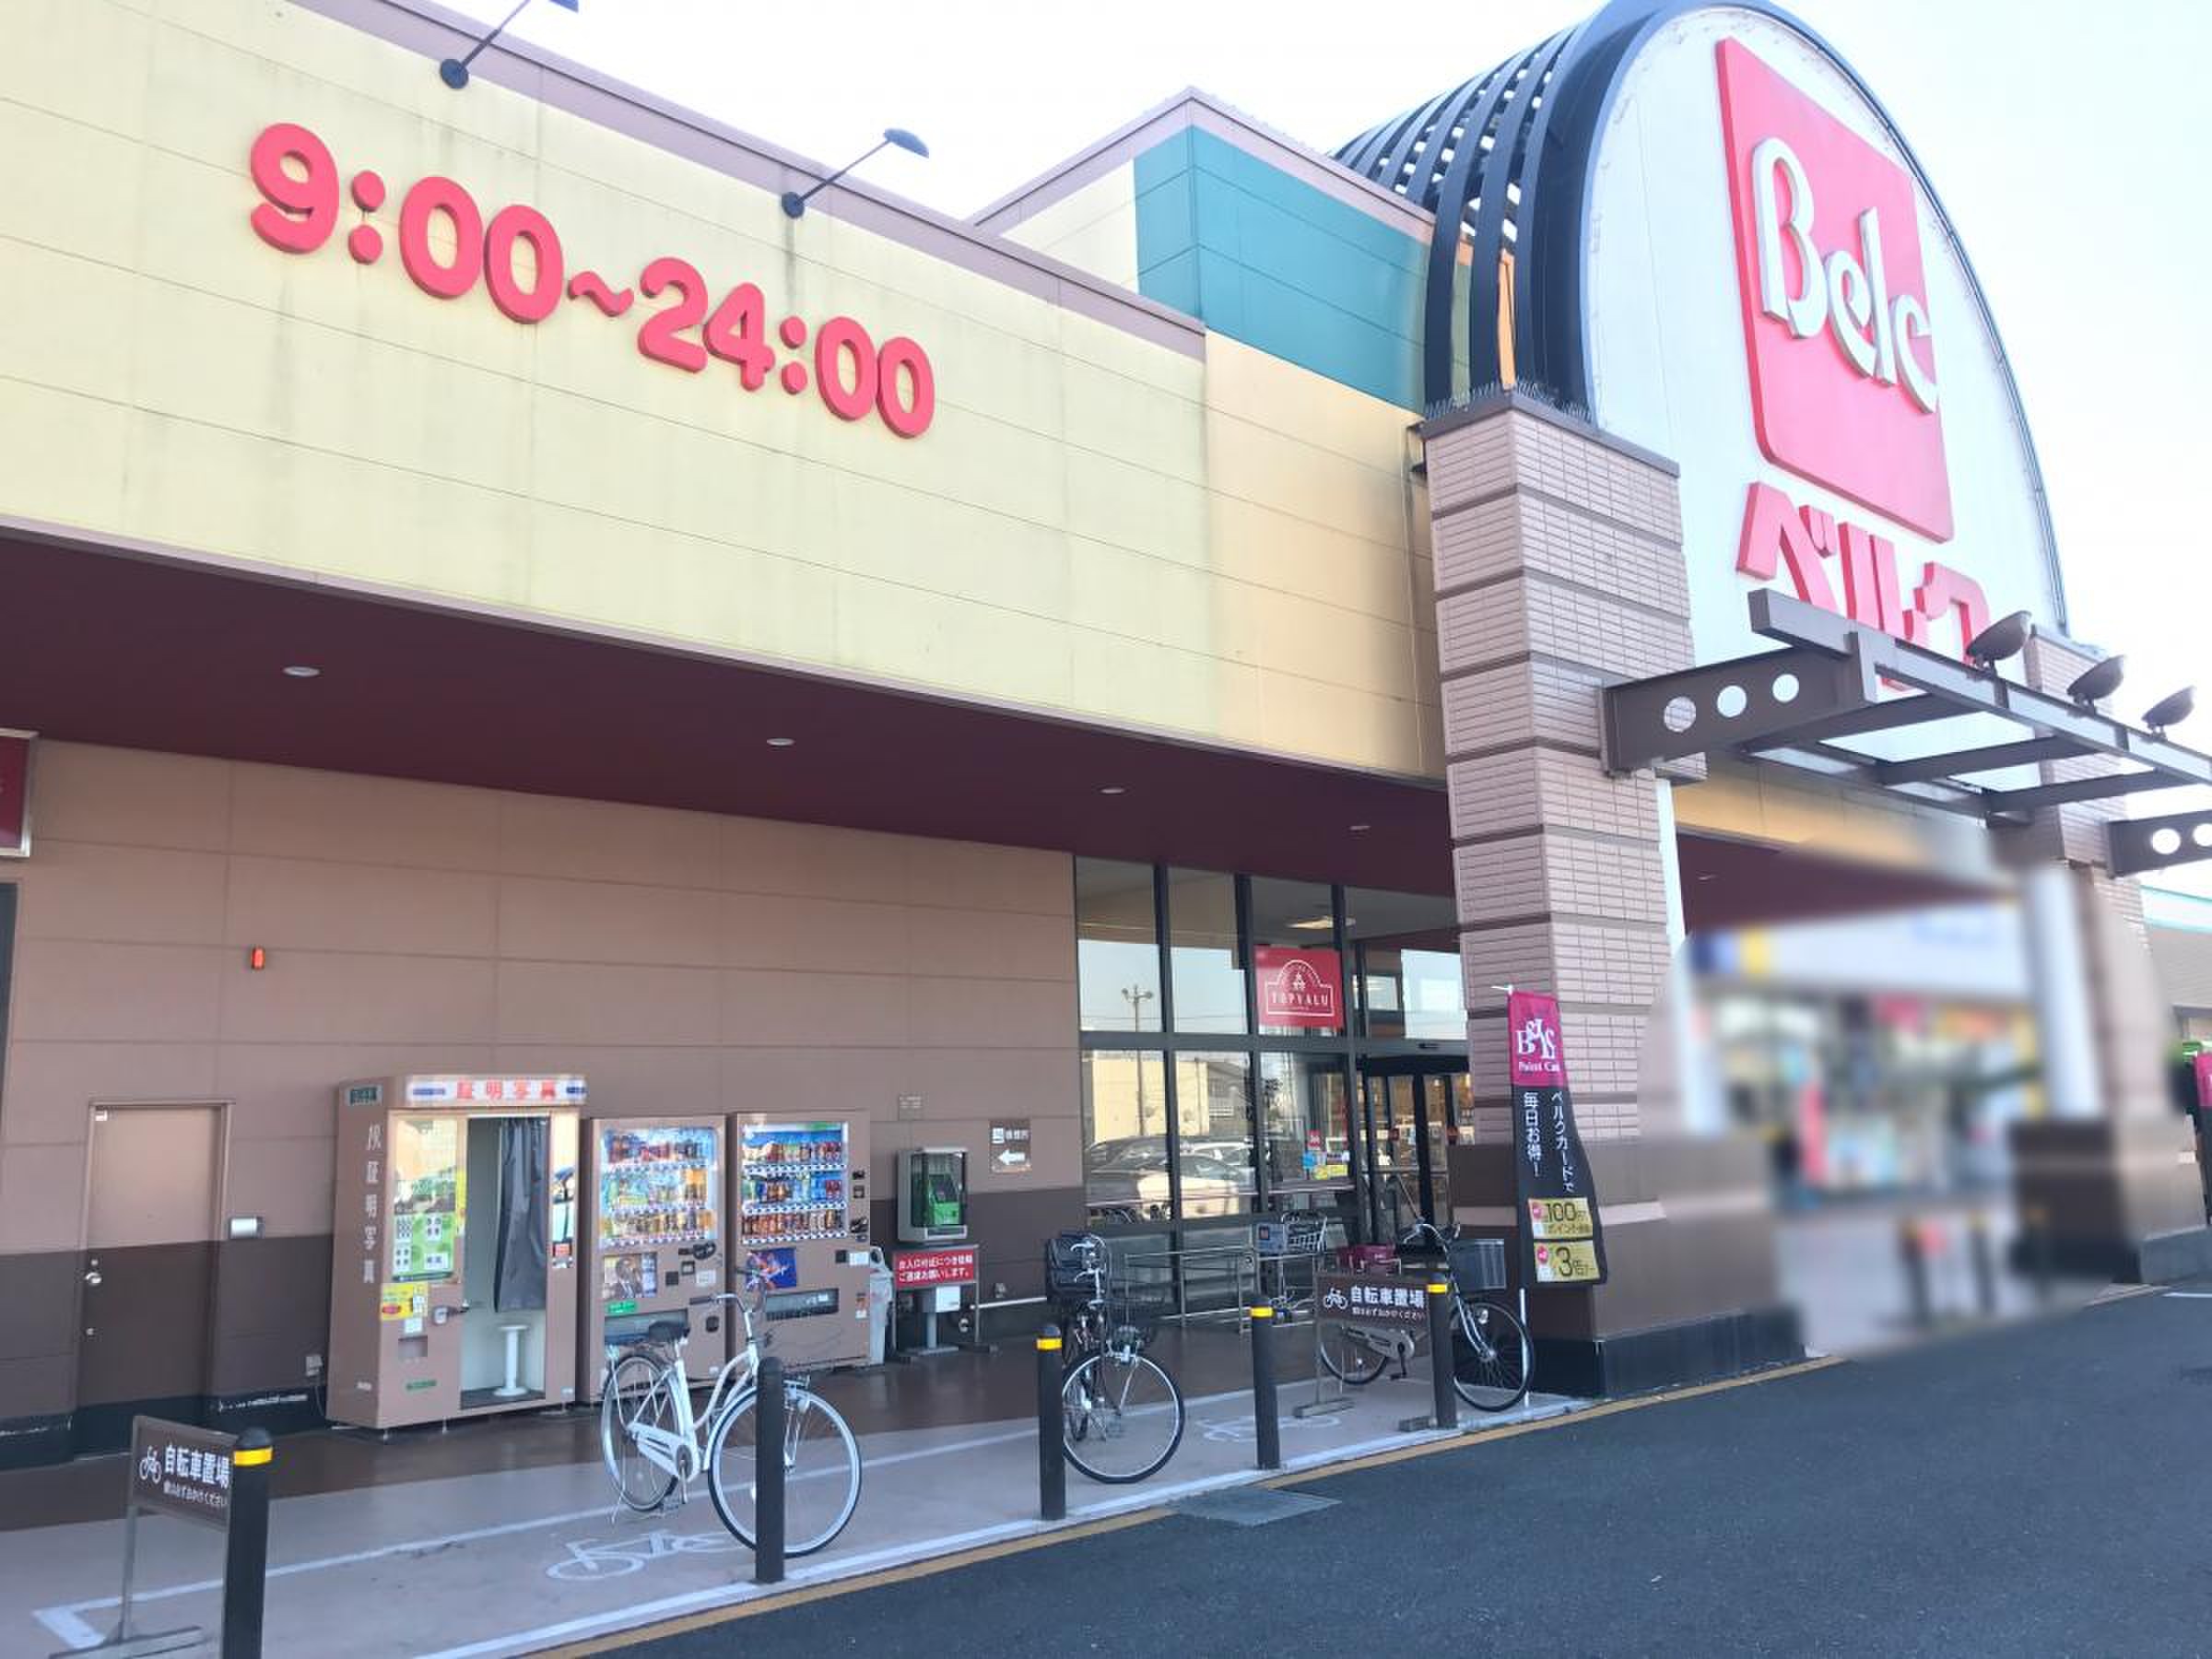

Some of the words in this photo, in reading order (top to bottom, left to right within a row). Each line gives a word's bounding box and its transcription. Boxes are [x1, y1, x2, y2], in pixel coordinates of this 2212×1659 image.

[1752, 136, 1938, 415] Belc
[1547, 1202, 1577, 1222] 100
[1350, 1285, 1426, 1310] 自転車置場
[164, 1443, 229, 1489] 自転車置場
